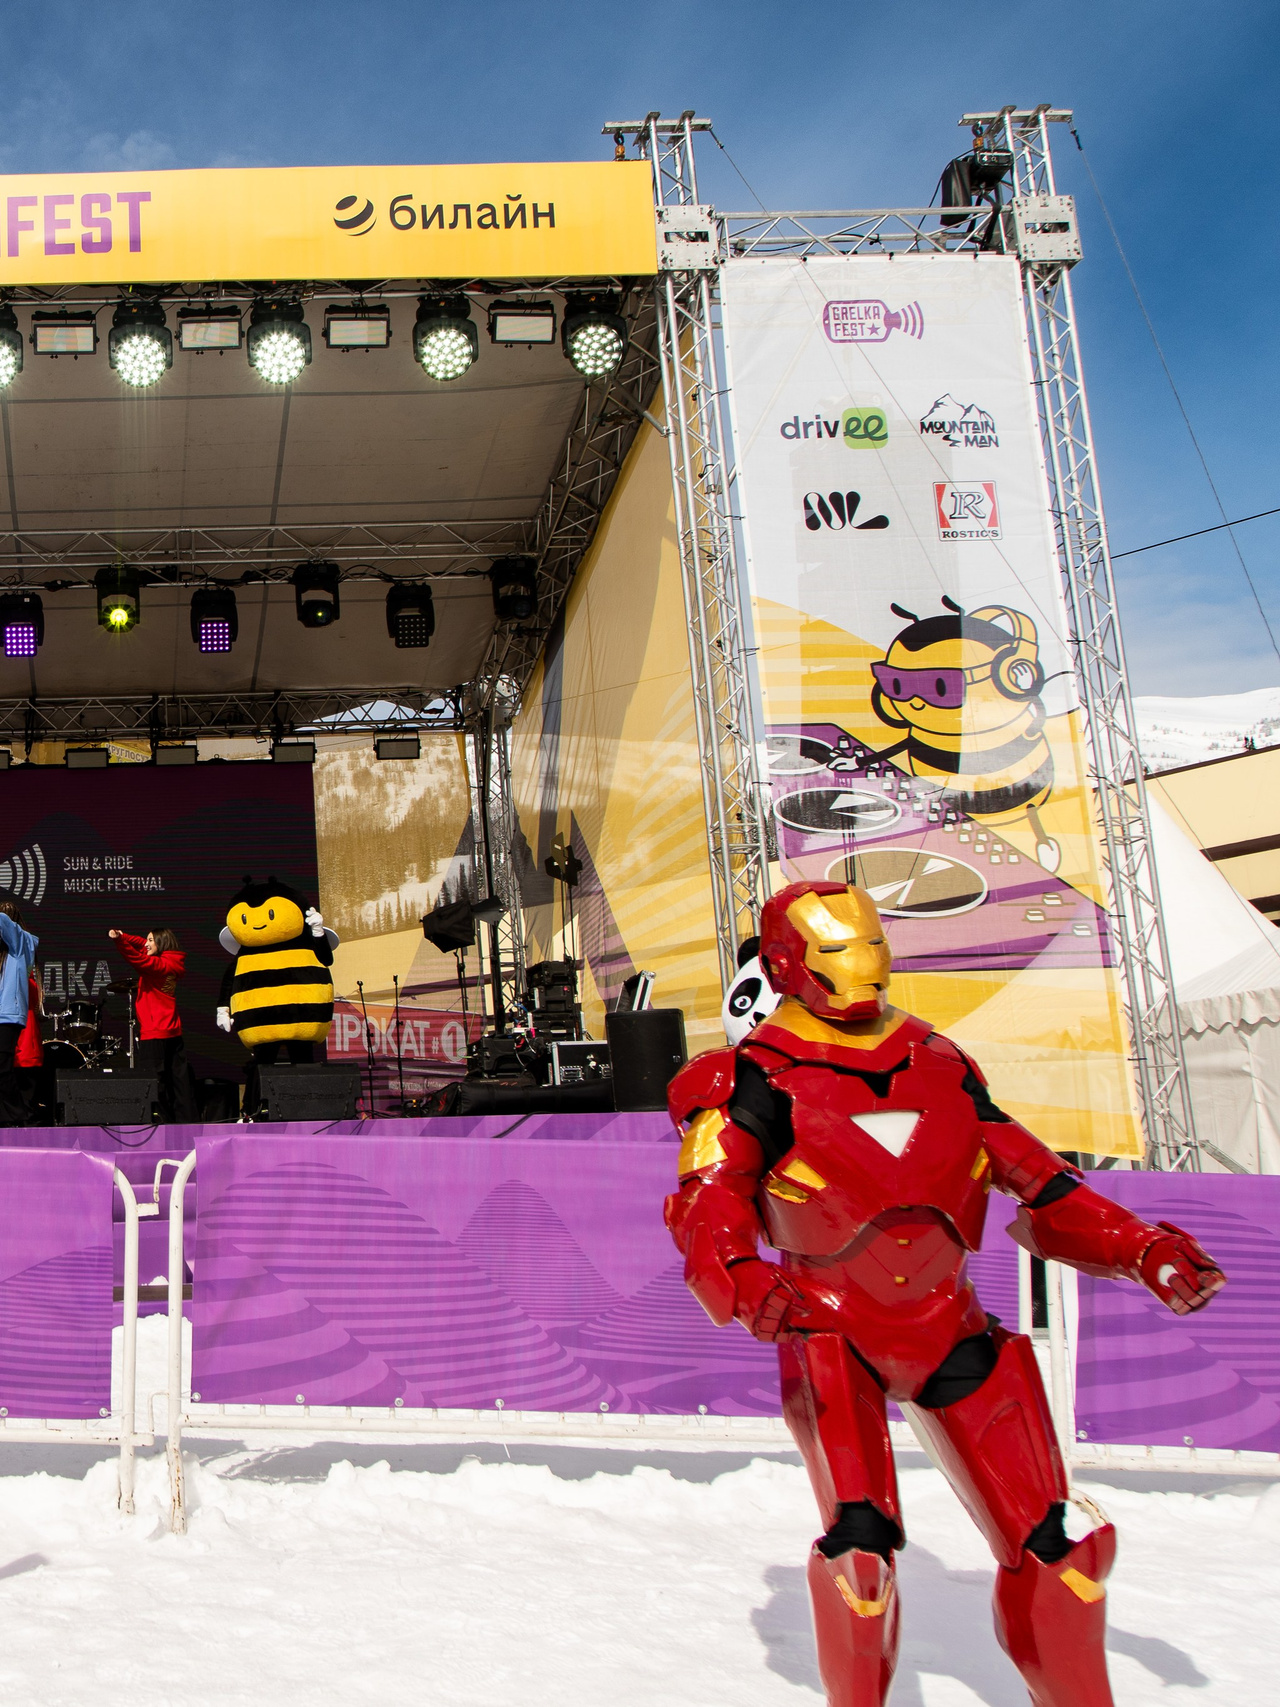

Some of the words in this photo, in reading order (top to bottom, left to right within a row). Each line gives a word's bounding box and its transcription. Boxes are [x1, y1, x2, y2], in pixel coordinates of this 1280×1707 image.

[389, 193, 556, 231] билайн
[832, 306, 881, 320] GRELKA
[834, 322, 866, 337] FEST
[780, 414, 889, 440] drivee
[920, 420, 996, 434] MOUNTAIN
[964, 434, 999, 448] MAN
[942, 529, 999, 539] ROSTIC'S
[63, 856, 89, 870] SUN
[92, 856, 102, 869] &
[104, 856, 133, 870] RIDE
[64, 878, 105, 892] MUSIC
[107, 877, 165, 892] FESTIVAL
[325, 1012, 430, 1057] ПРОКАТ
